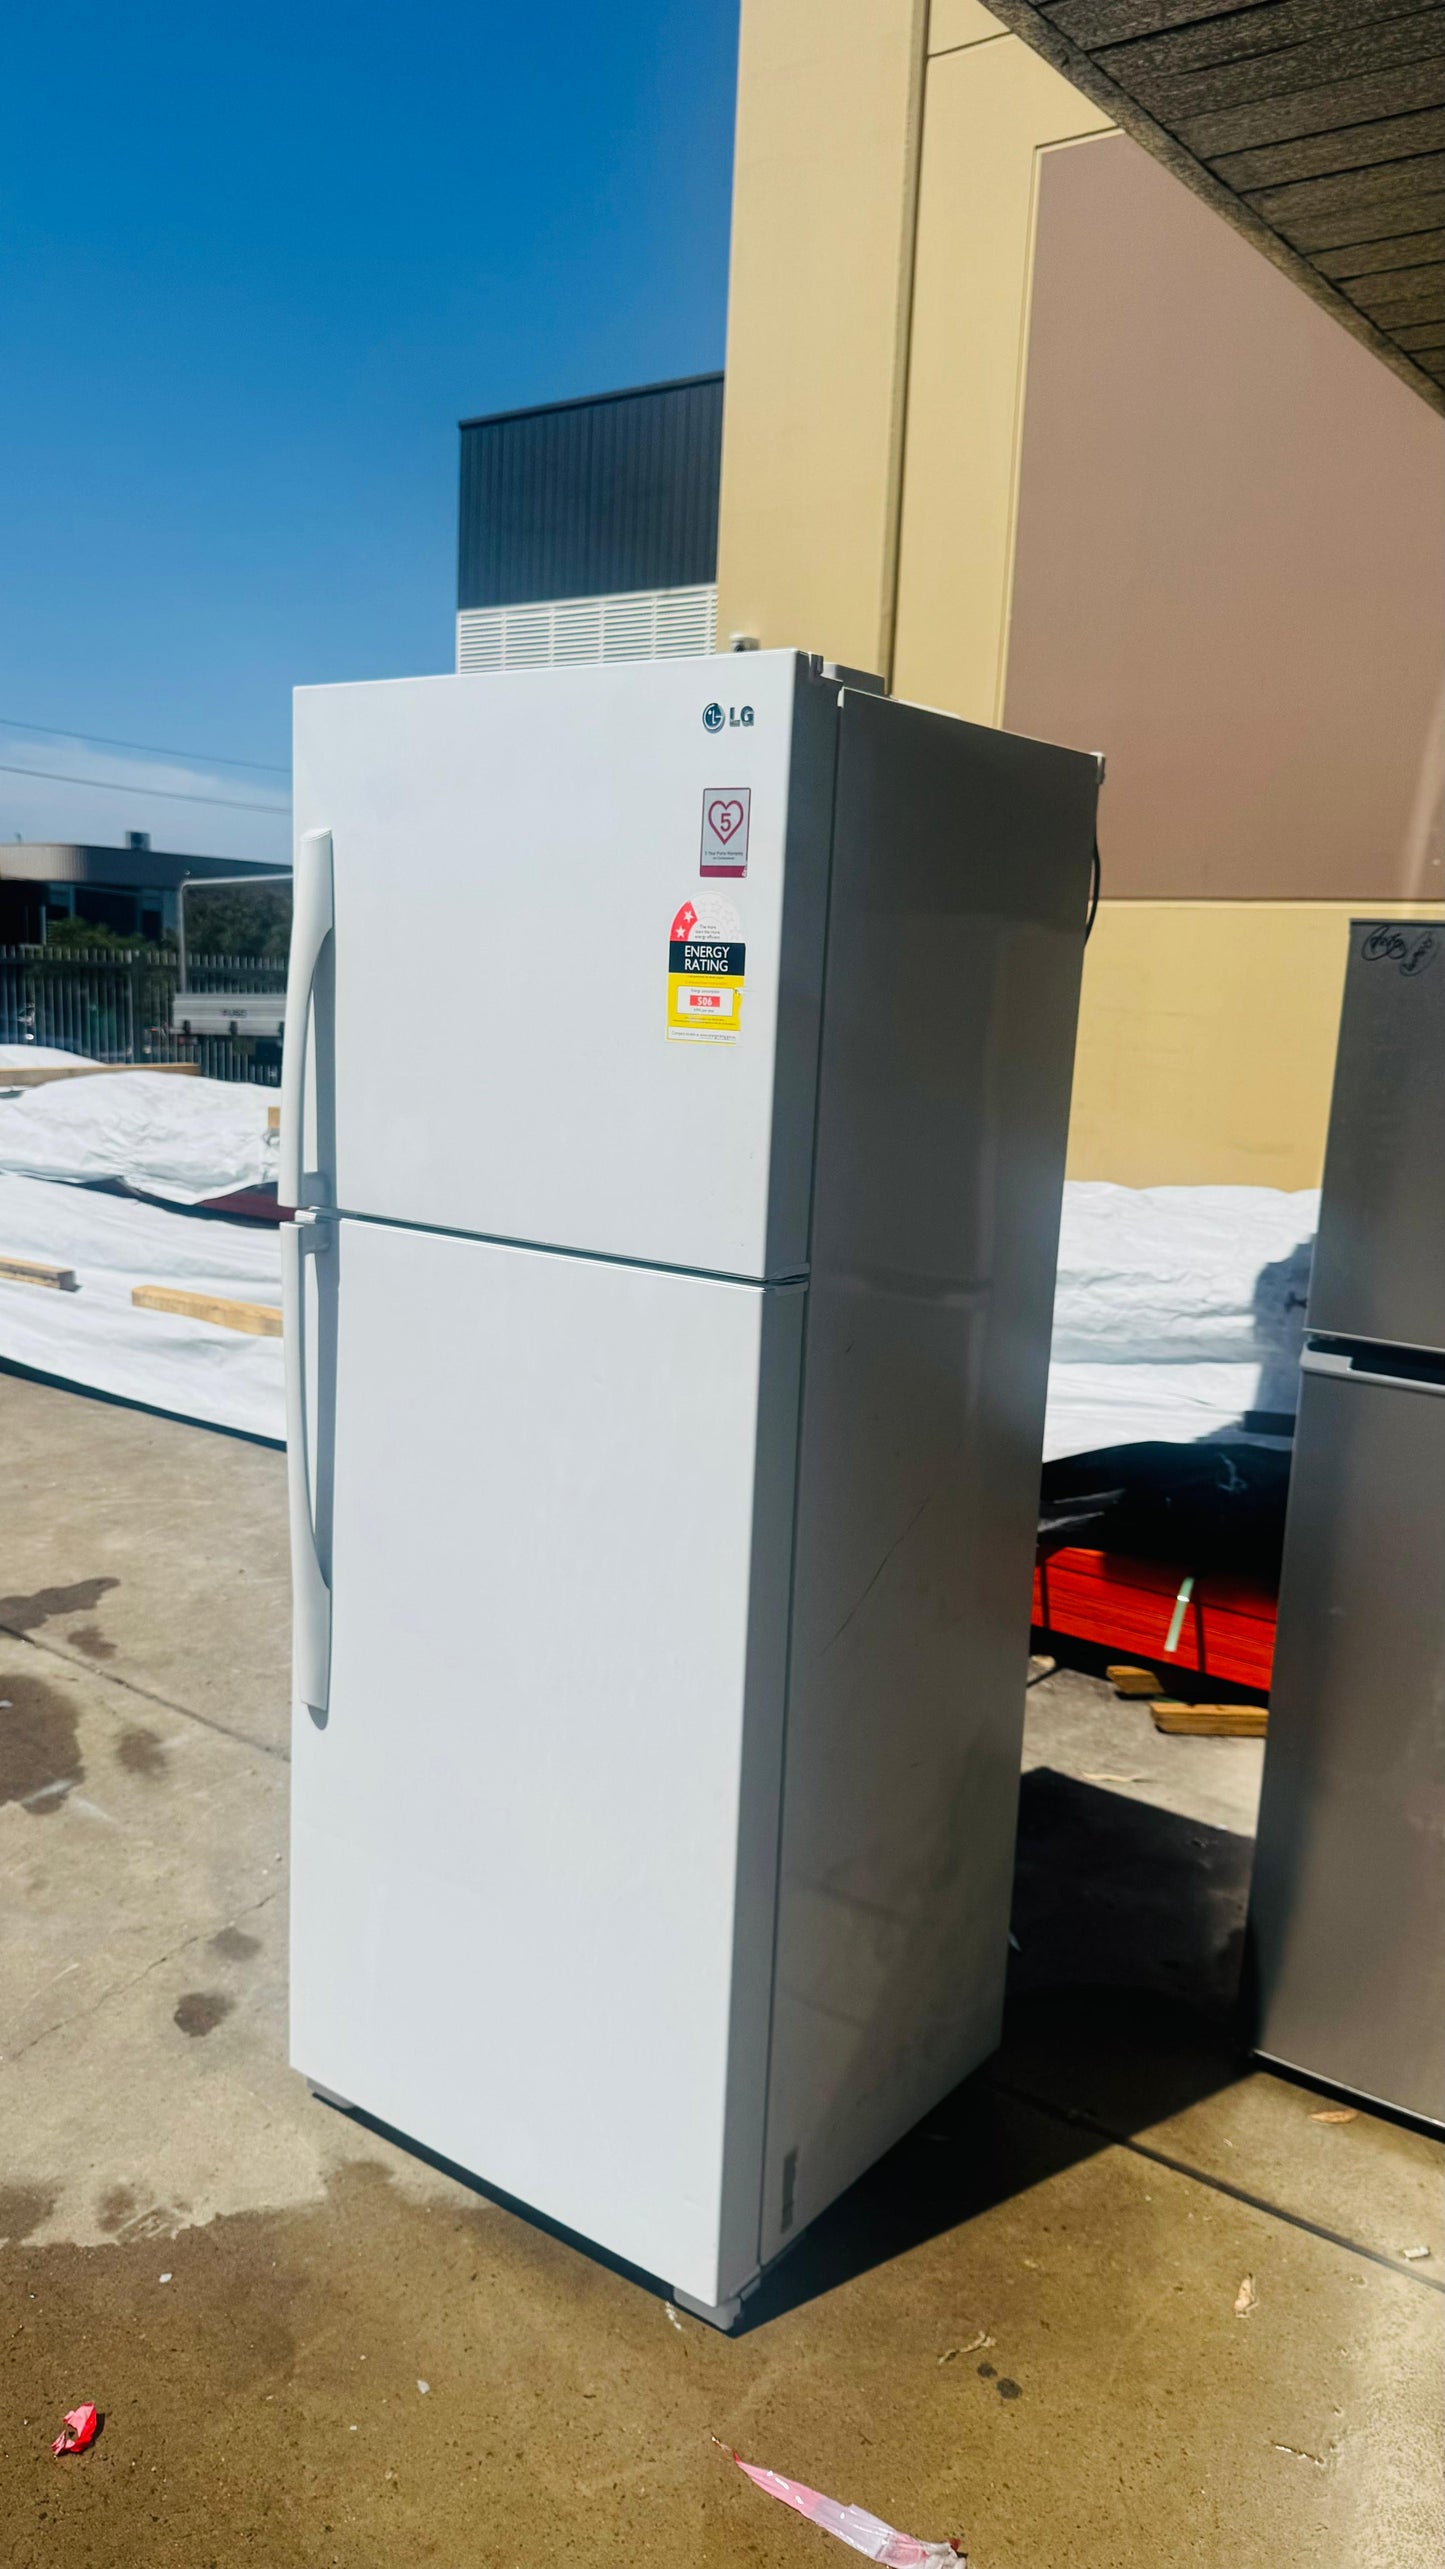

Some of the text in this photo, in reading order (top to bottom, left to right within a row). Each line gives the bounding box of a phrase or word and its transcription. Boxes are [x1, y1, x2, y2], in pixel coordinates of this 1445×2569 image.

[729, 705, 754, 727] LG
[720, 813, 731, 831] 5
[684, 945, 730, 959] ENERGY
[684, 958, 729, 972] RATING
[697, 996, 713, 1006] 506
